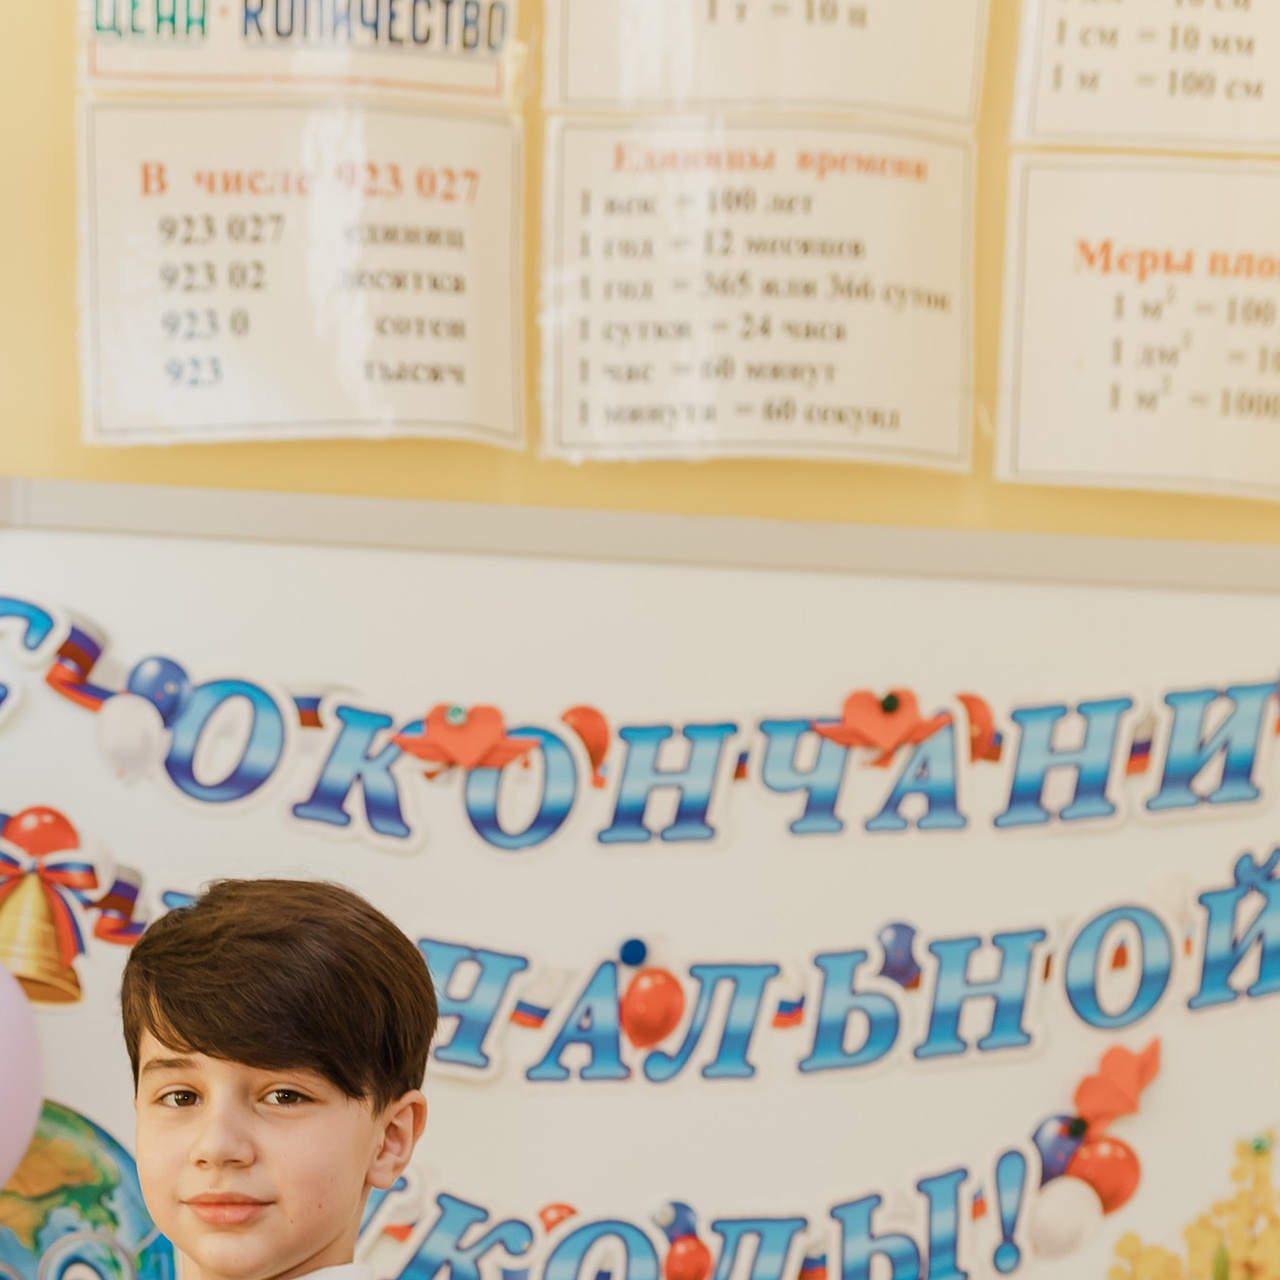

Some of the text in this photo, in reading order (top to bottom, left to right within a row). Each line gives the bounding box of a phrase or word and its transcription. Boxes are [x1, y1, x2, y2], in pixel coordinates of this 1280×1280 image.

[139, 161, 168, 196] В
[415, 167, 481, 204] 027
[1075, 239, 1195, 284] Меры
